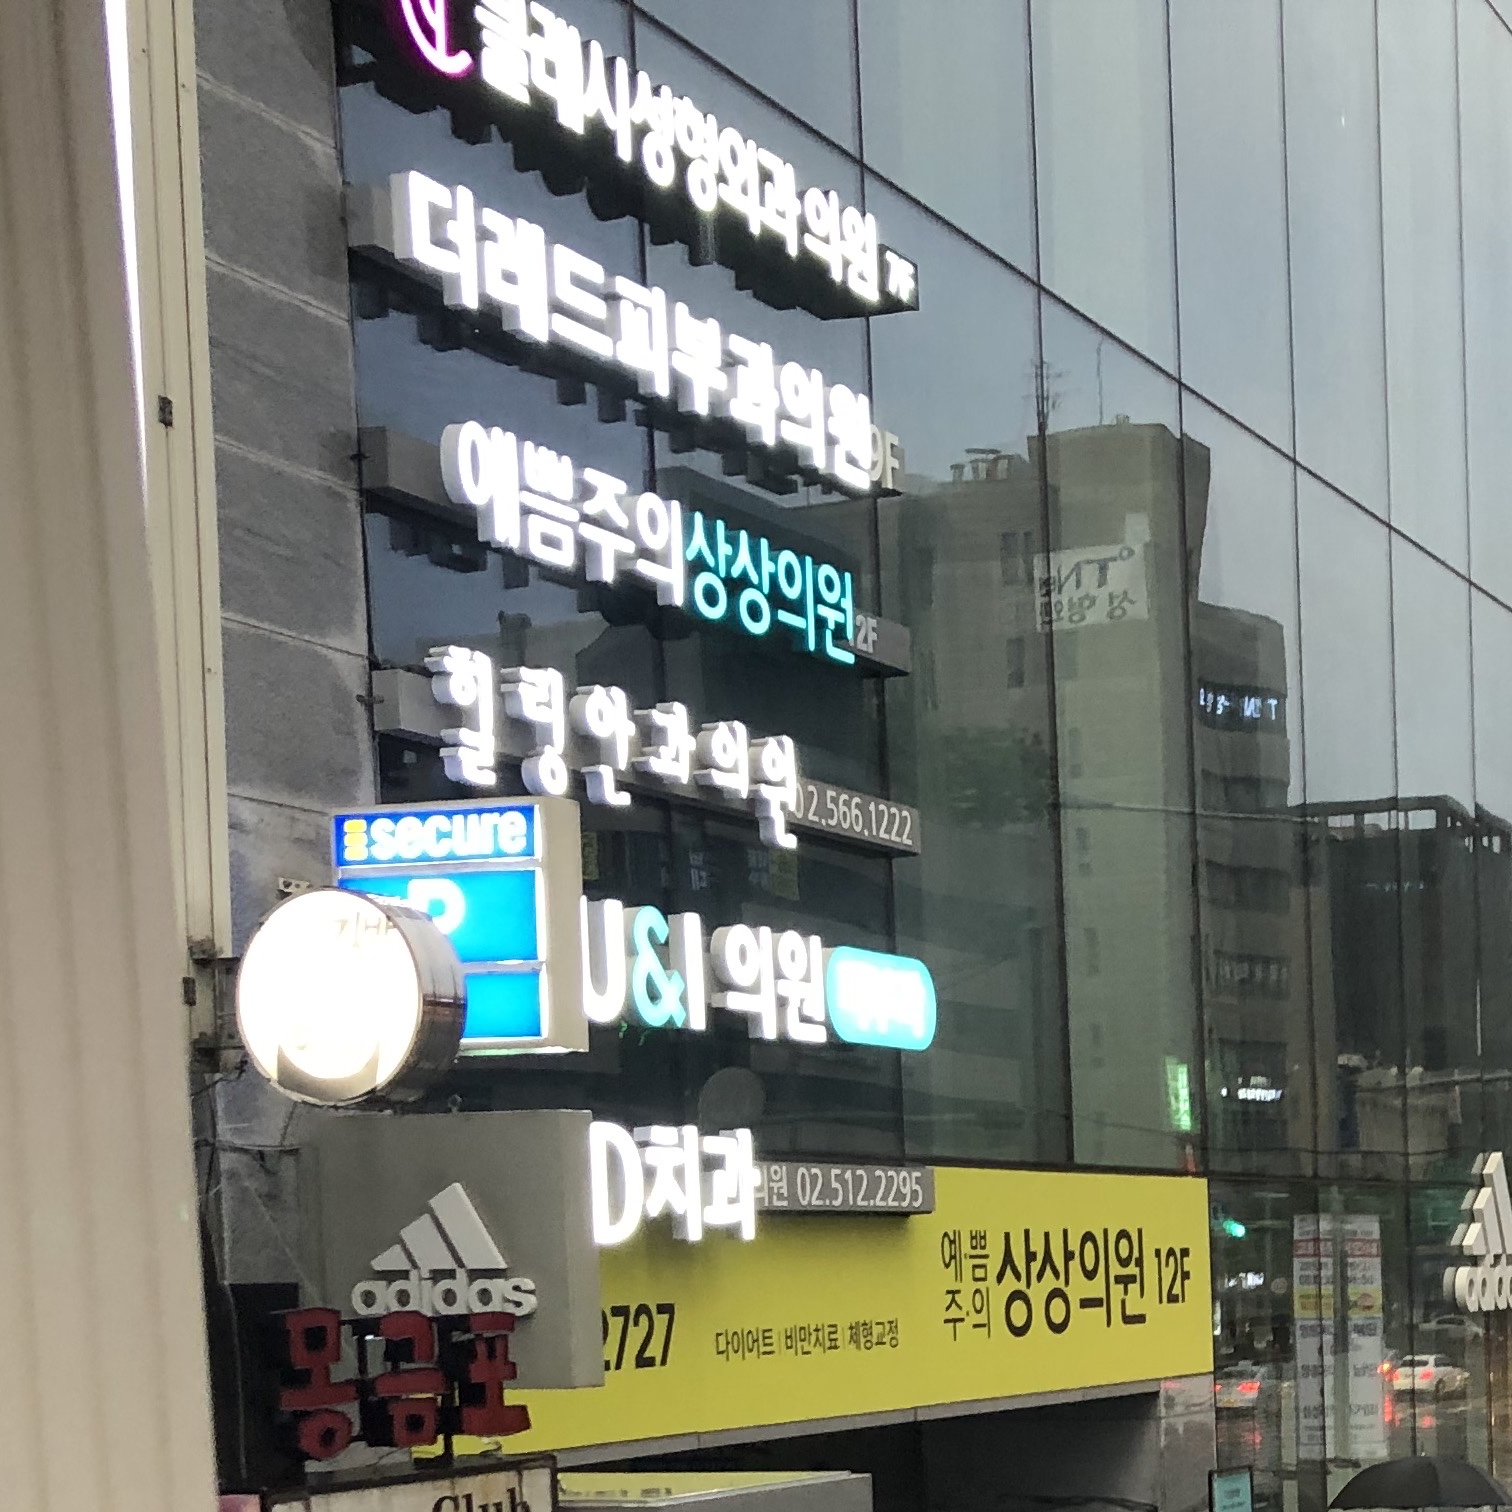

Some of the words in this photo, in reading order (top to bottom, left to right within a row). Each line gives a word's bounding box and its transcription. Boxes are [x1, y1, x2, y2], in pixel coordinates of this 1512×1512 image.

[405, 170, 871, 490] 더레드피부과의원
[870, 425, 899, 488] 9F
[686, 511, 856, 664] 상상의원
[433, 646, 798, 849] 힐링안과의원
[582, 898, 706, 1030] U&I
[723, 925, 827, 1042] 의원
[590, 1121, 756, 1244] D치과
[797, 1166, 924, 1208] 02.512.2295
[352, 1268, 538, 1317] adidas
[941, 1229, 990, 1283] 예쁨
[943, 1286, 992, 1342] 주의
[996, 1227, 1147, 1338] 상상의원
[1154, 1246, 1191, 1305] 12F
[715, 1326, 775, 1361] 다이어트
[784, 1322, 840, 1356] 비만치료
[847, 1317, 899, 1352] 체형교정
